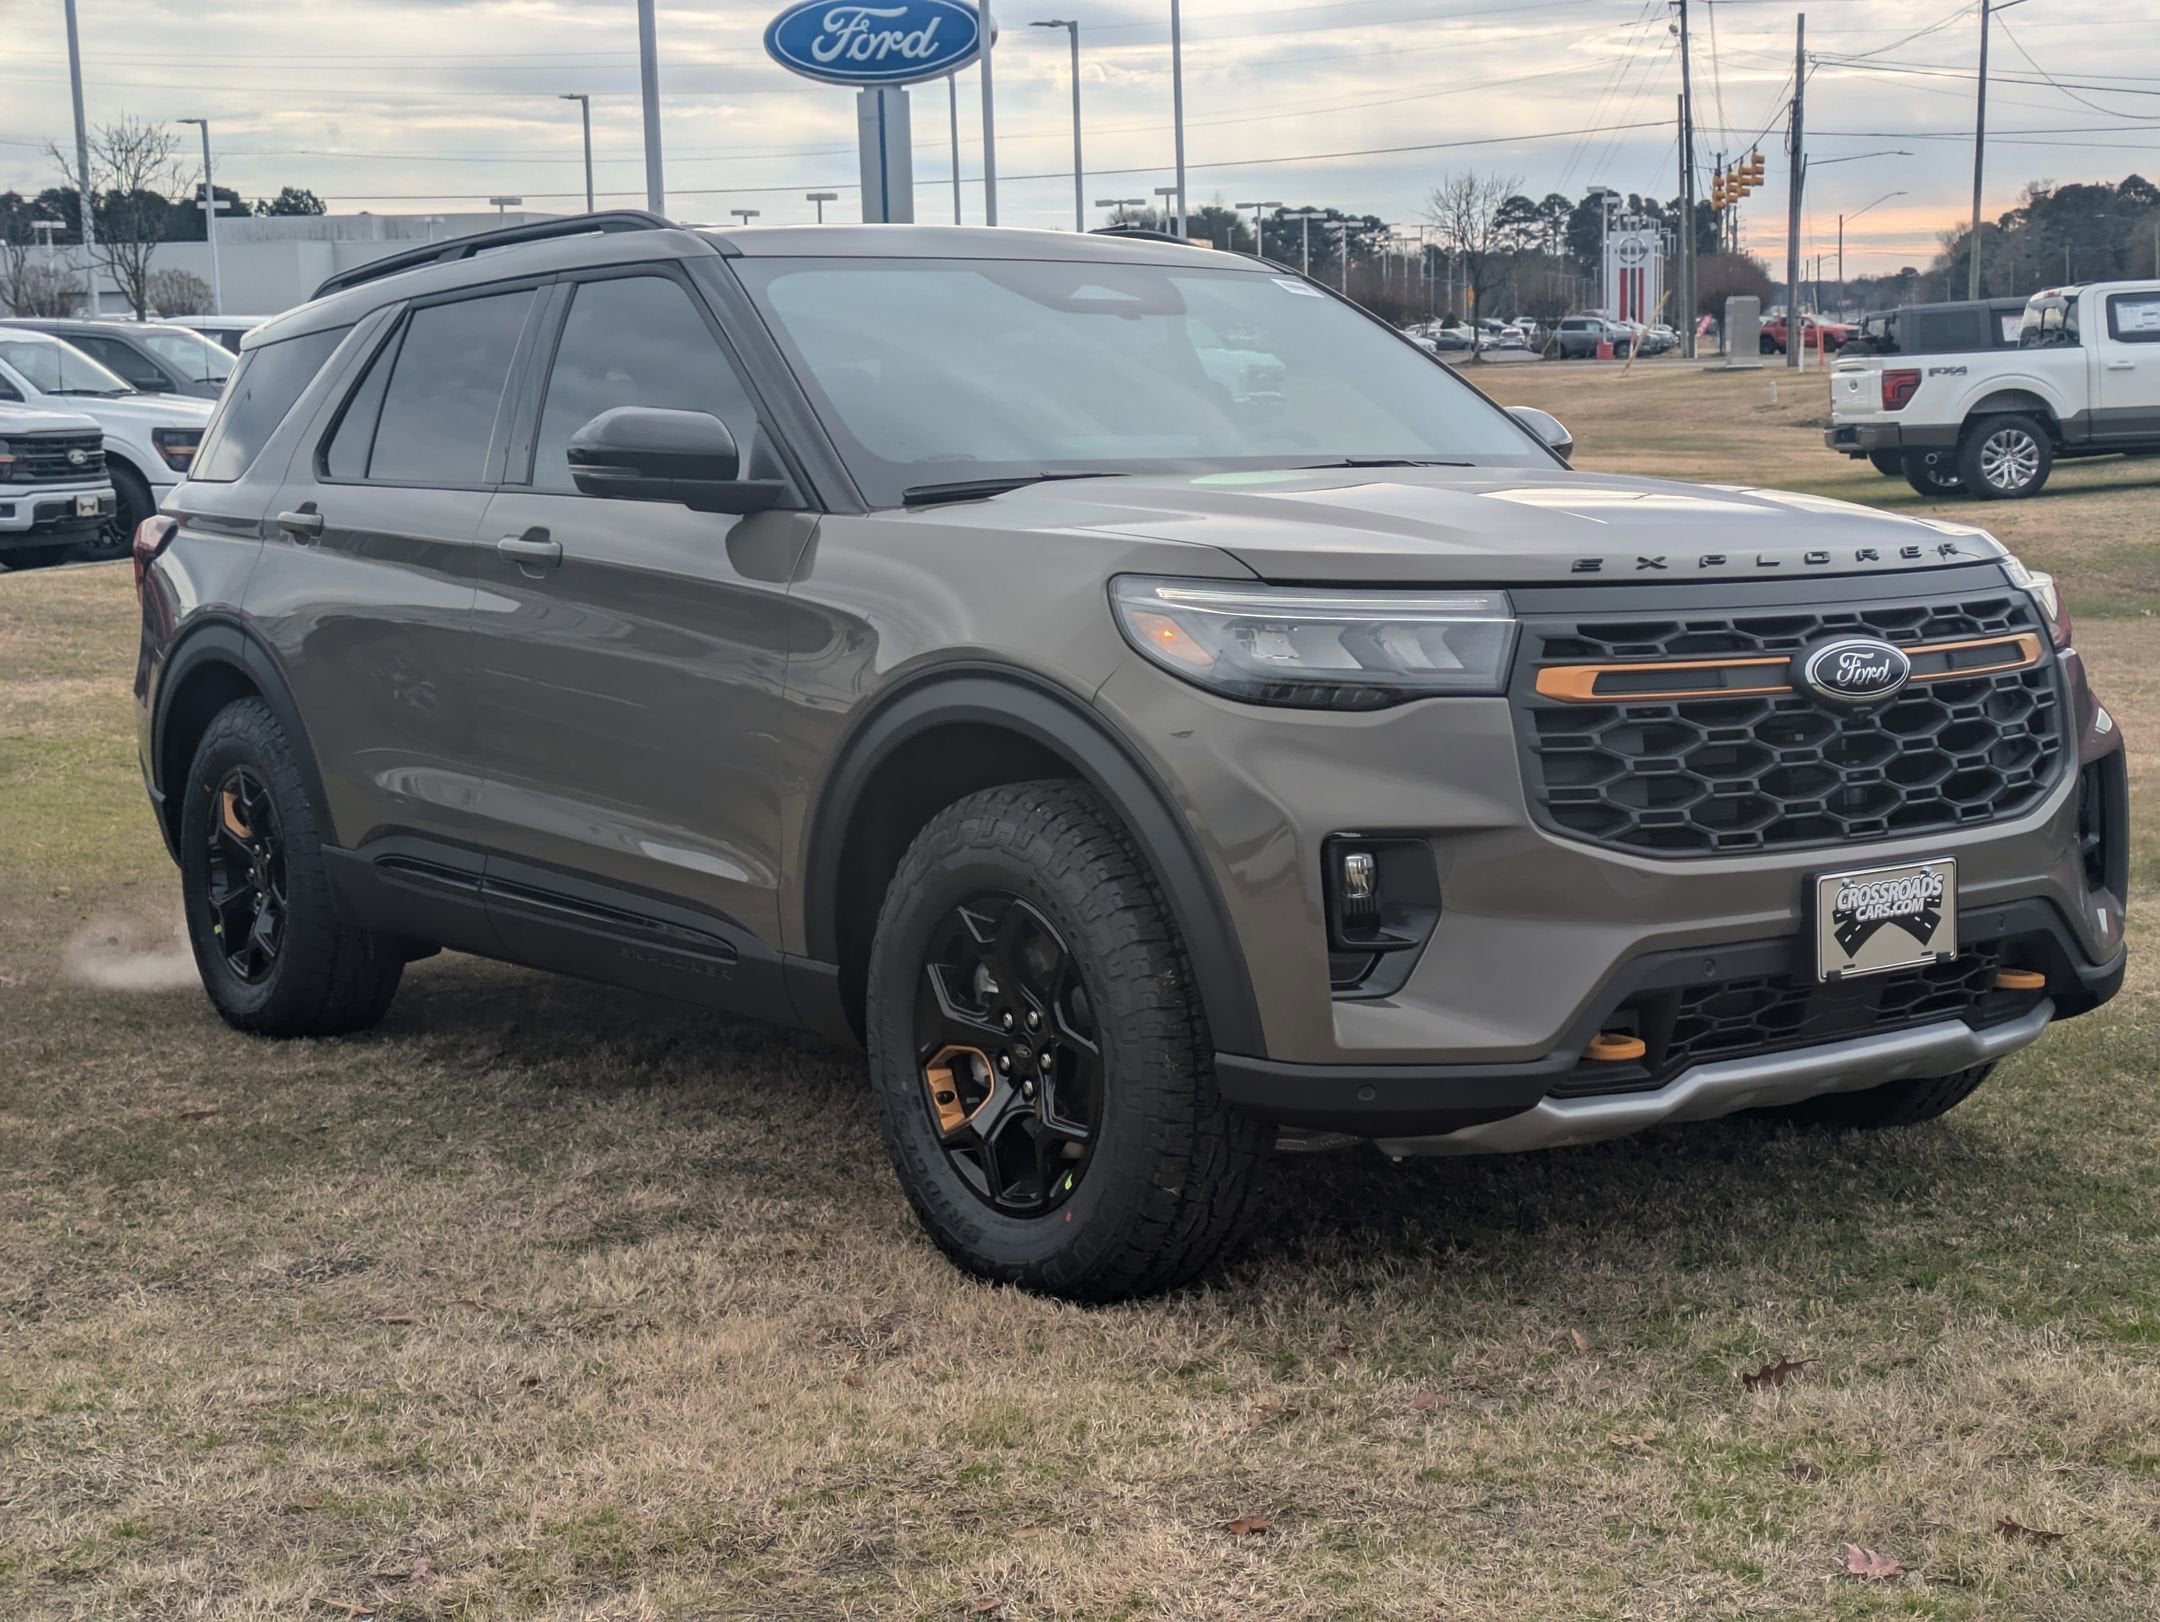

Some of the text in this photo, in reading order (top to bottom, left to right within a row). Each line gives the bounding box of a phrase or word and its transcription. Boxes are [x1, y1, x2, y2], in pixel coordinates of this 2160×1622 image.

[812, 7, 942, 61] Ford
[1928, 366, 1968, 377] FX4
[1571, 542, 1959, 573] EXPLORER
[1836, 652, 1892, 686] Ford
[1836, 873, 1944, 911] CROSSROADS
[1855, 898, 1925, 922] CARS.COM
